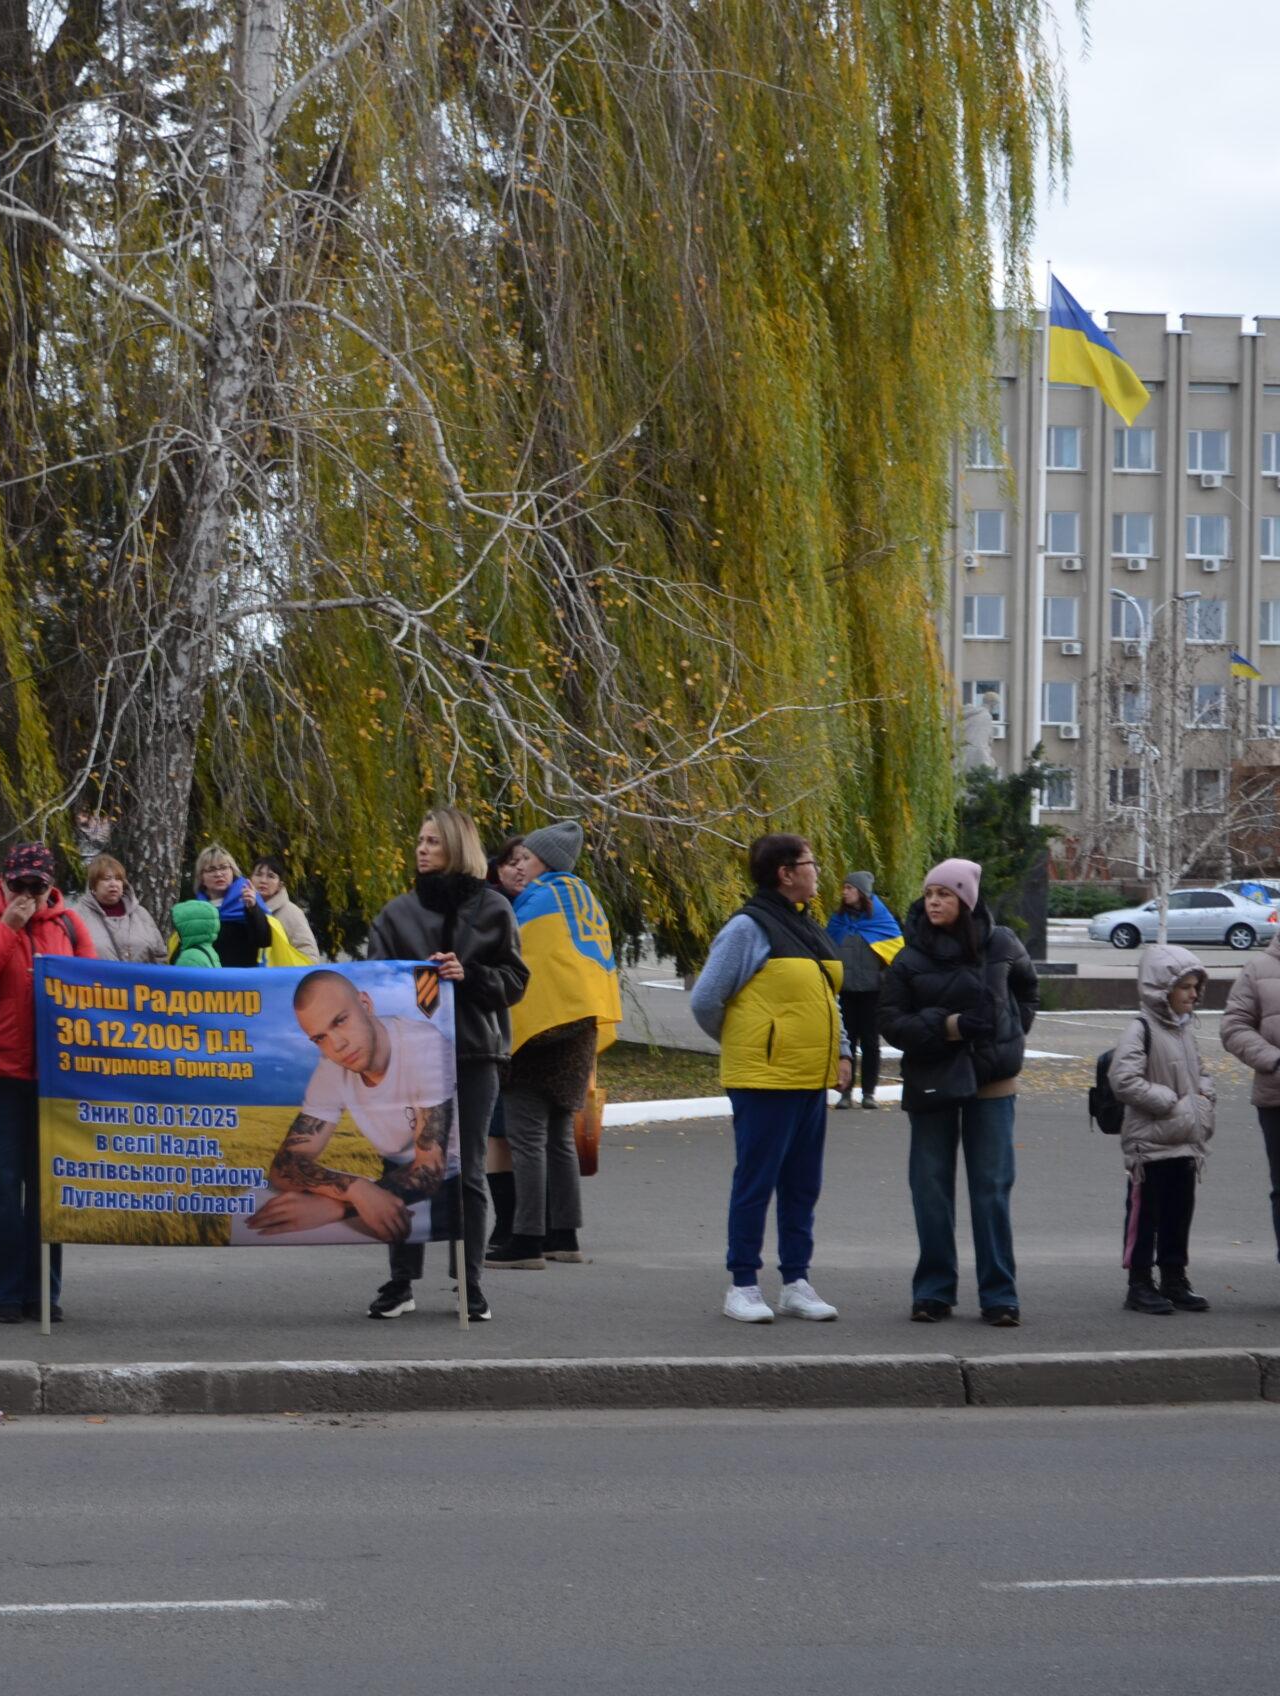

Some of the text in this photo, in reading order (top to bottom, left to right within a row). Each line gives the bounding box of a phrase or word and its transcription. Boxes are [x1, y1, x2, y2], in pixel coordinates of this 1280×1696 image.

[44, 977, 262, 1017] Чуріш Радомир
[56, 1017, 254, 1055] 30.12.2005 р.н.
[58, 1051, 254, 1080] 3 штурмова бригада
[78, 1101, 239, 1129] Зник 08.01.2025
[96, 1134, 224, 1159] в селі Надія,
[52, 1156, 269, 1189] Сватівського району,
[61, 1186, 256, 1214] Луганської області
